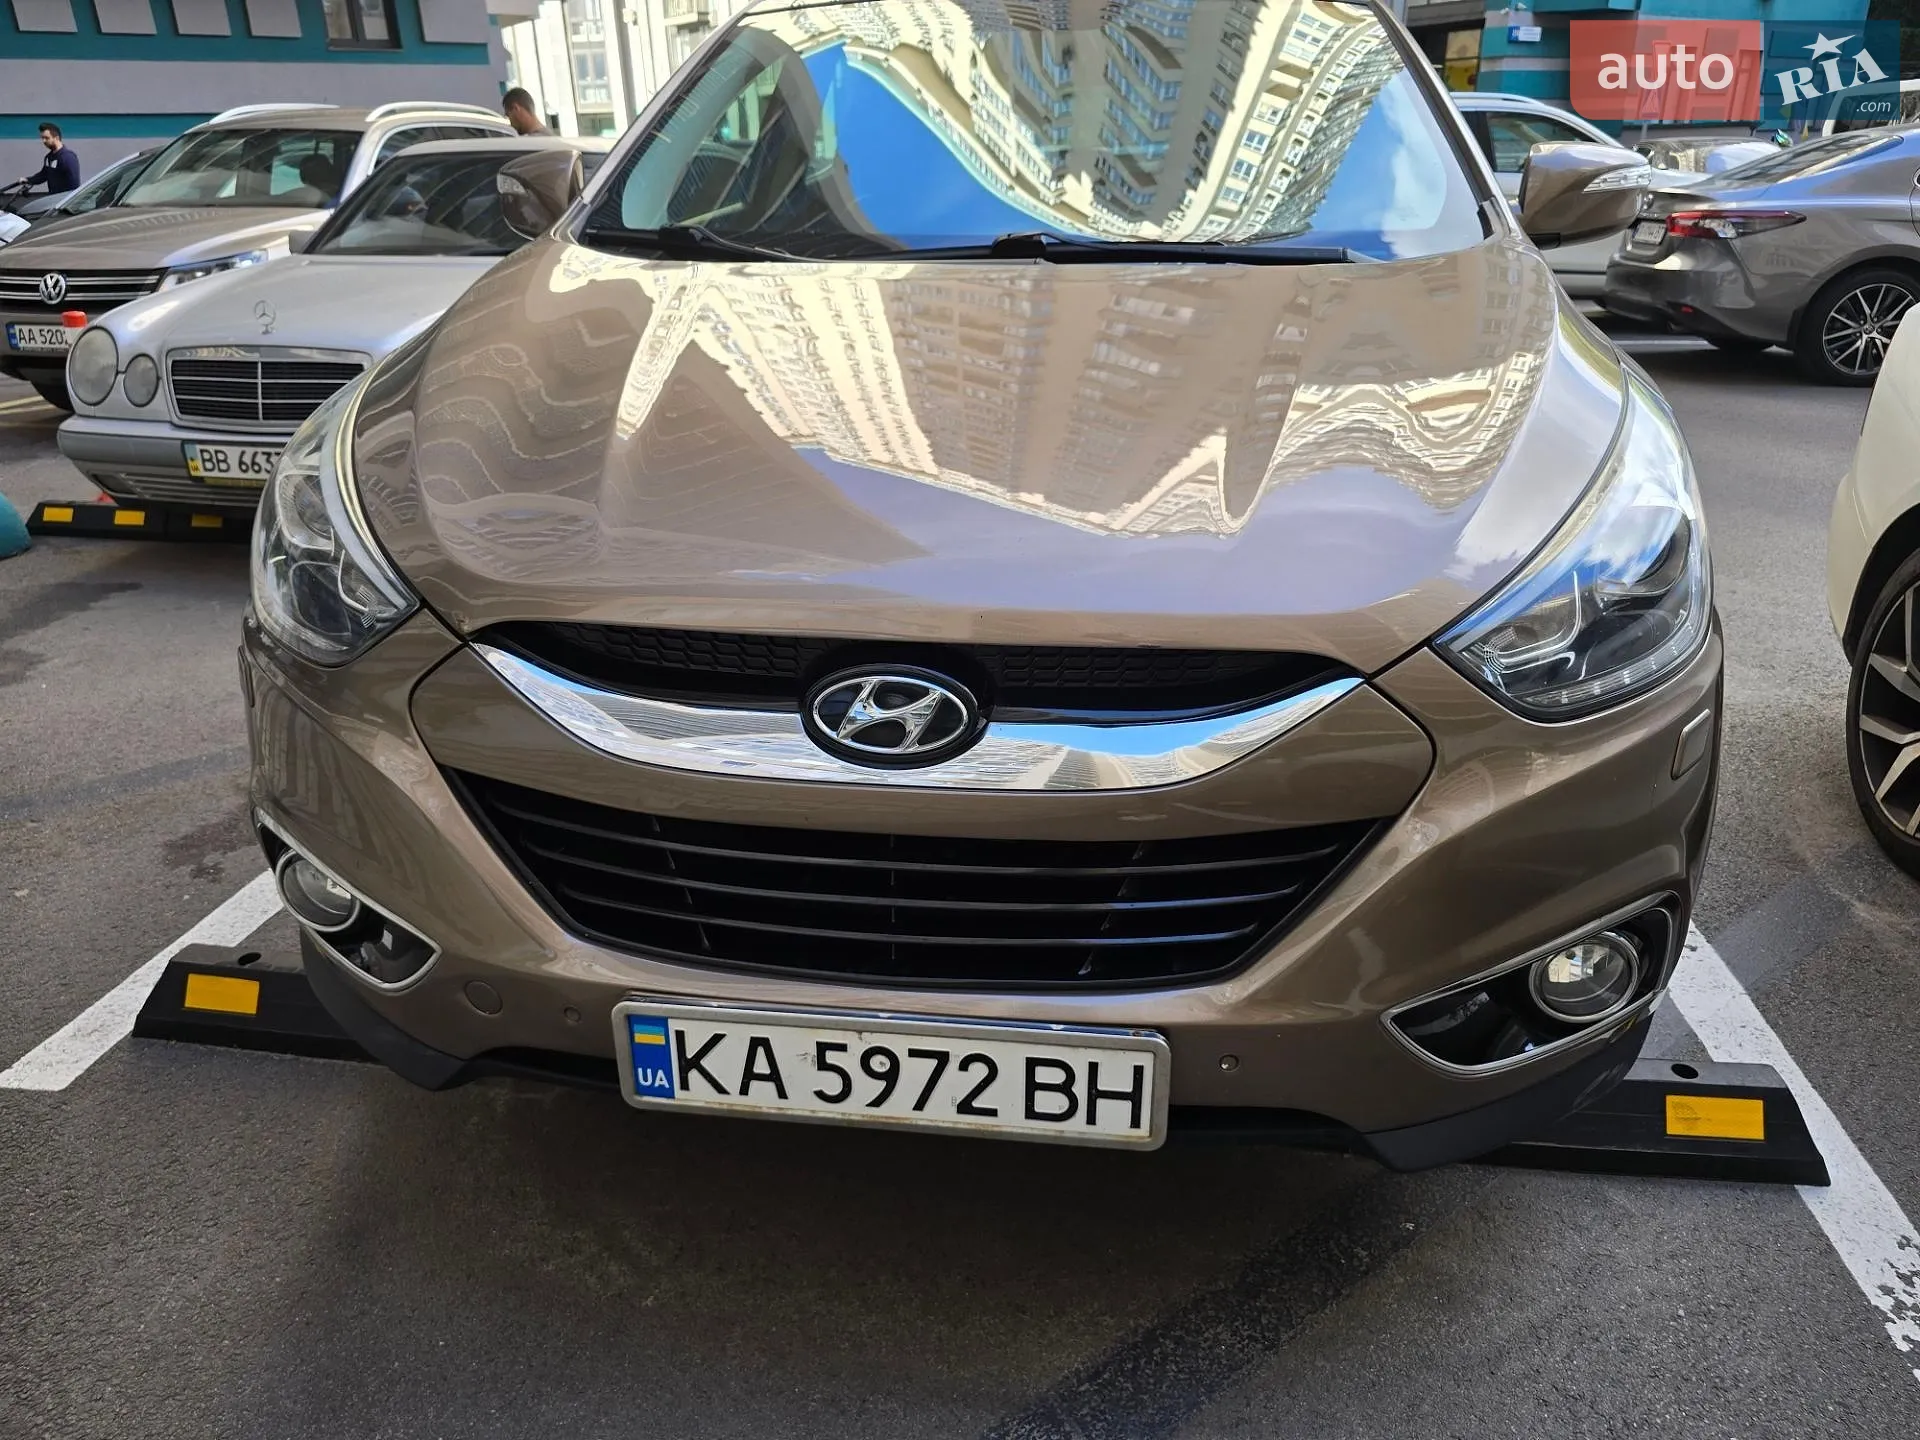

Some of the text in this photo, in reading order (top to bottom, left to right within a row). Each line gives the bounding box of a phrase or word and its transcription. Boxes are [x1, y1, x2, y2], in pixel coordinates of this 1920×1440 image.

[18, 328, 37, 345] AA
[199, 448, 231, 473] BB
[637, 1067, 670, 1089] UA
[674, 1029, 1144, 1129] KA 5972 BH
